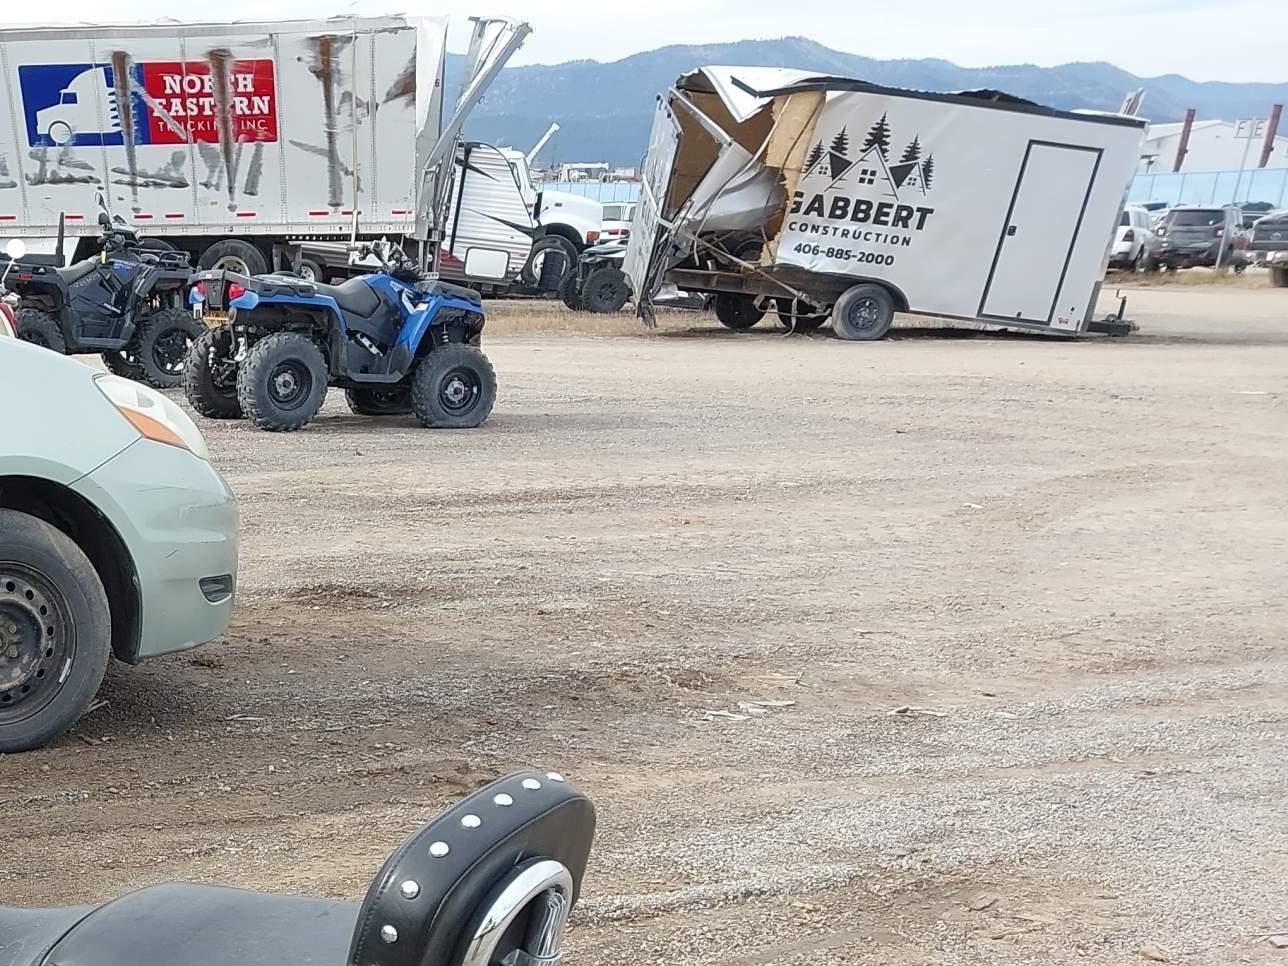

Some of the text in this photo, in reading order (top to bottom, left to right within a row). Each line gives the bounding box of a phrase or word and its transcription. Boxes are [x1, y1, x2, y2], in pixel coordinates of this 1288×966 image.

[163, 73, 255, 94] NORH
[152, 96, 271, 117] EASTRN
[789, 191, 935, 231] GABBERT
[788, 221, 912, 246] CONSTRUCTION
[793, 243, 895, 266] 406-885-2000
